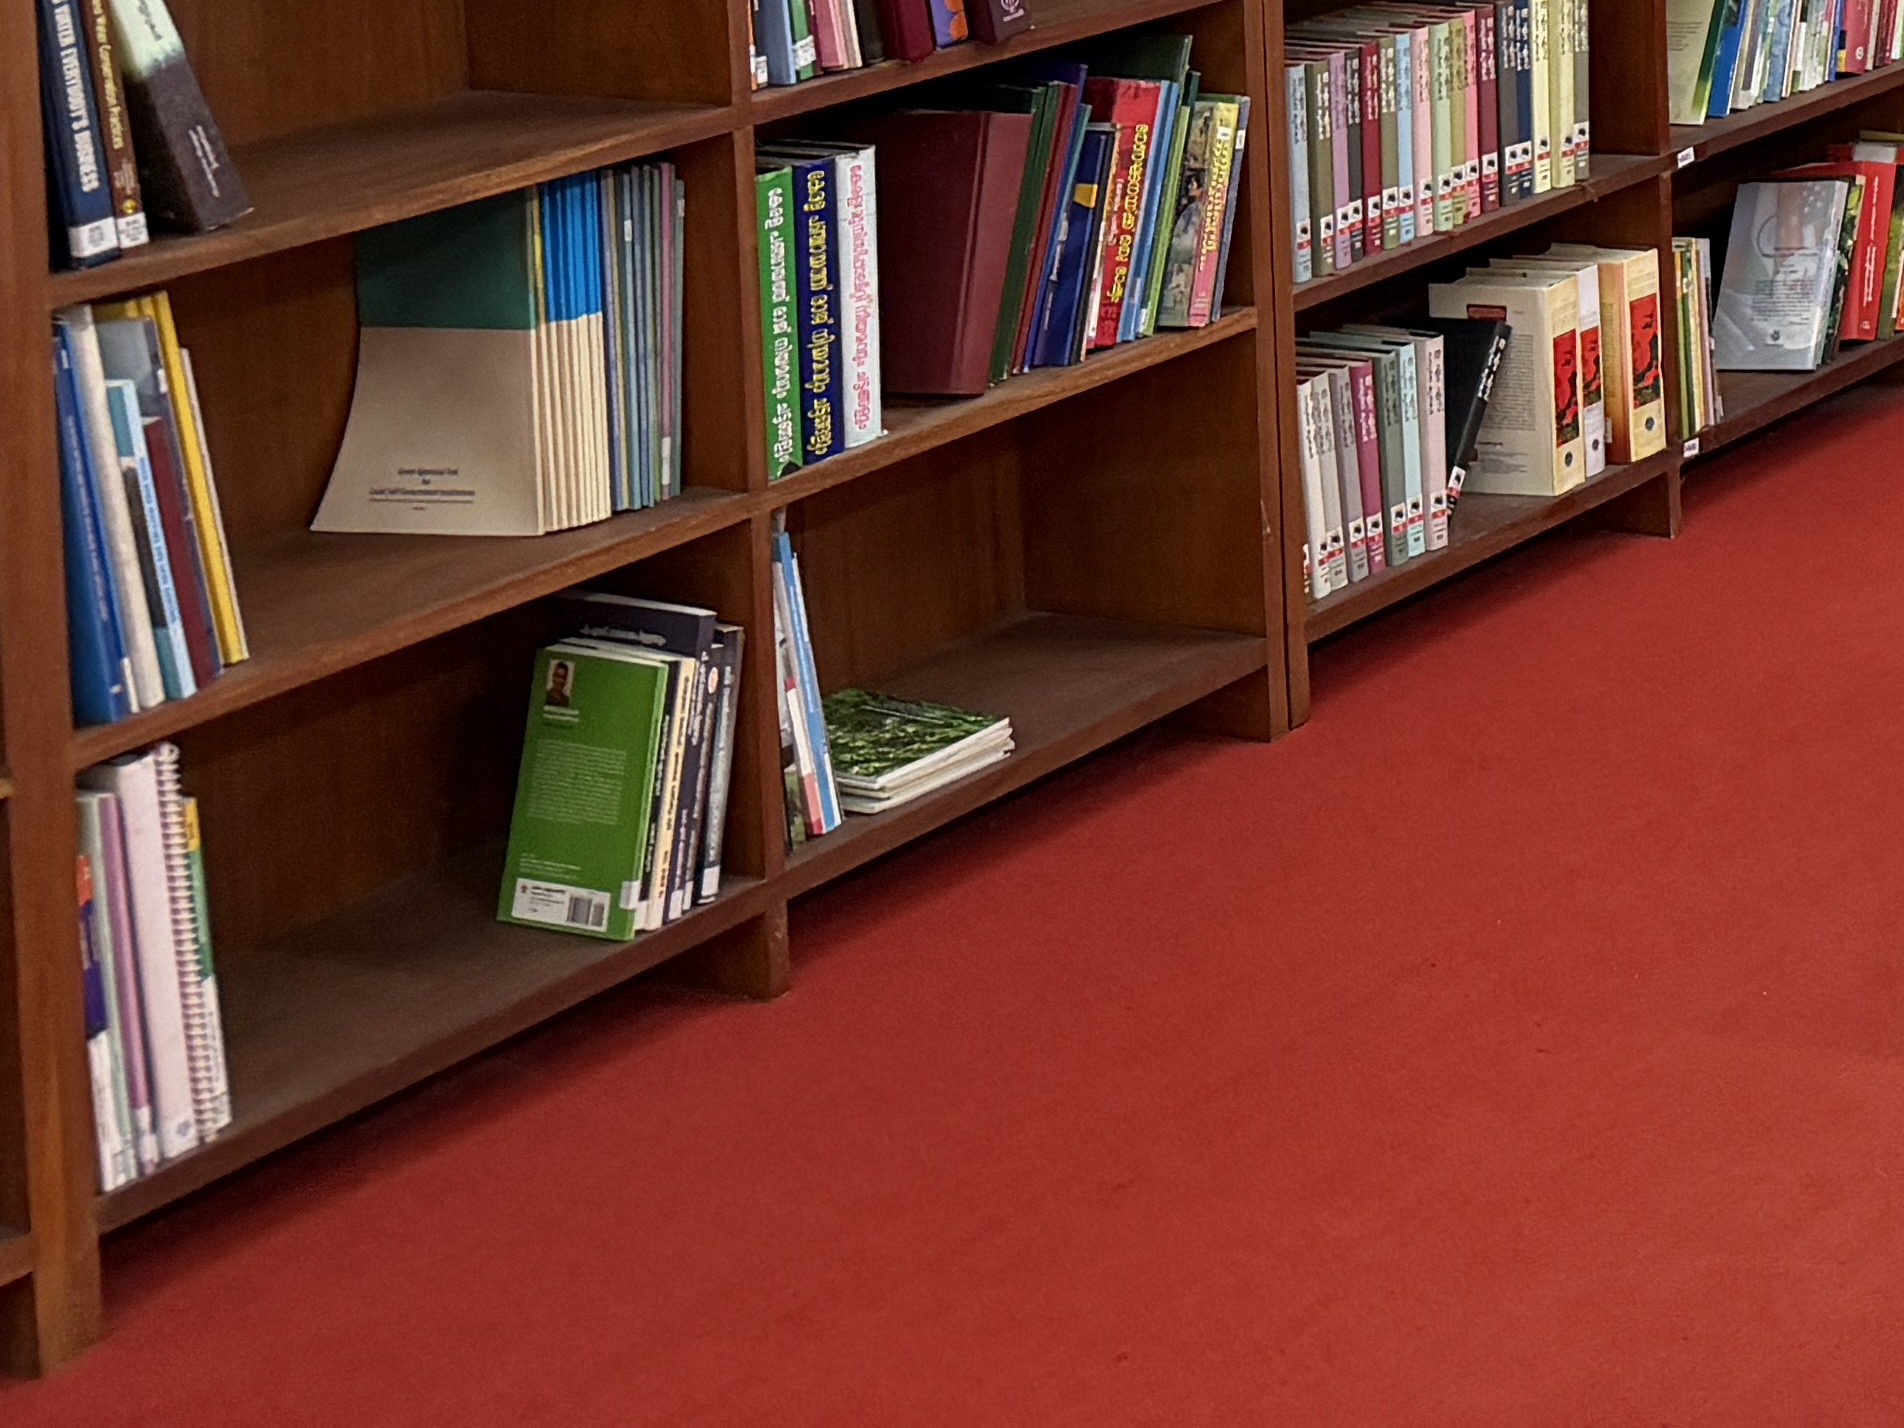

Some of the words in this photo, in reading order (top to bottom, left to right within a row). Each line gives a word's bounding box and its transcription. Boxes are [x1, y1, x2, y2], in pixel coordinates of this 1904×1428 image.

[54, 6, 76, 47] WATER
[59, 48, 90, 131] EVERYBODY'S
[96, 44, 120, 106] Conservation
[73, 131, 100, 193] BUSINESS
[804, 170, 826, 213] കേരള
